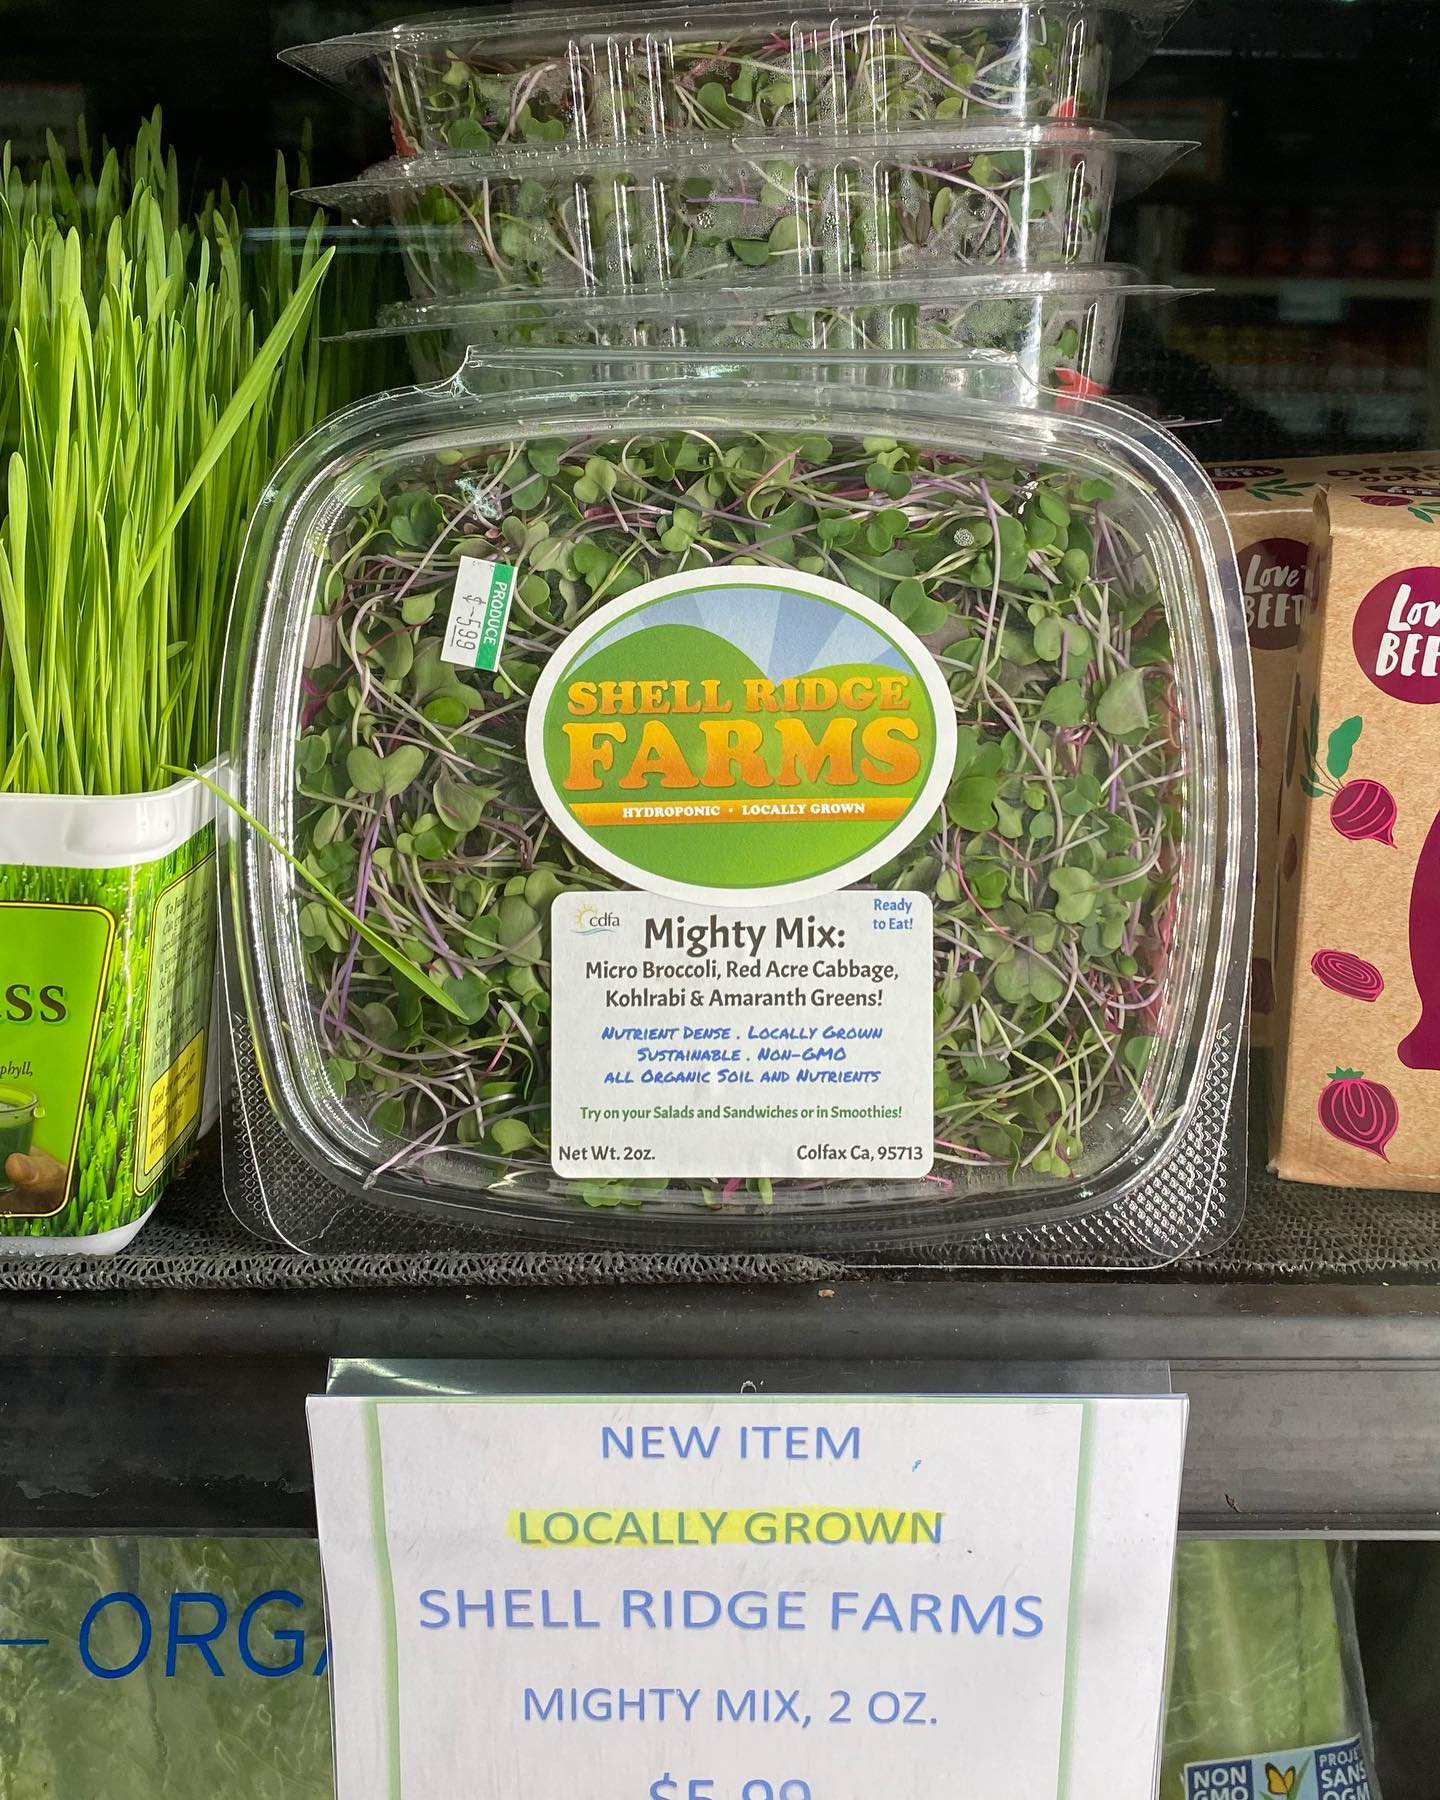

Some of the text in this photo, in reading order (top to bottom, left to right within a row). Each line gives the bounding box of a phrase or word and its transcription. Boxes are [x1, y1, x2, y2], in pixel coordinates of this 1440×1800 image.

[1244, 554, 1300, 594] Love
[482, 581, 508, 646] PRODUCE
[567, 677, 911, 715] SHELL RIDGE
[562, 717, 922, 791] FARMS
[622, 803, 865, 819] HYDROPONIC LOCALLY GROWN
[589, 912, 620, 927] cdfa
[873, 898, 912, 913] Ready
[644, 914, 846, 957] Mighty Mix:
[873, 918, 913, 930] to Eat!
[586, 959, 899, 983] Micro Broccoli, Red Acre Cabbage,
[0, 984, 67, 1023] SS
[606, 987, 883, 1007] Kohlrabi & Amaranth Greens!
[580, 1105, 903, 1122] Try on your Salads and Sandwiches or in Smoothies!
[559, 1145, 656, 1160] Net Wt. 2oz.
[797, 1144, 923, 1162] Colfax Ca, 95713
[602, 1426, 861, 1459] NEW ITEM
[519, 1511, 942, 1545] LOCALLY GROWN
[419, 1589, 1044, 1637] SHELL RIDGE FARMS
[79, 1590, 328, 1679] ORG
[524, 1688, 937, 1728] MIGHTY MIX, 2 OZ.
[1193, 1765, 1247, 1789] NON
[1321, 1760, 1366, 1788] SANS
